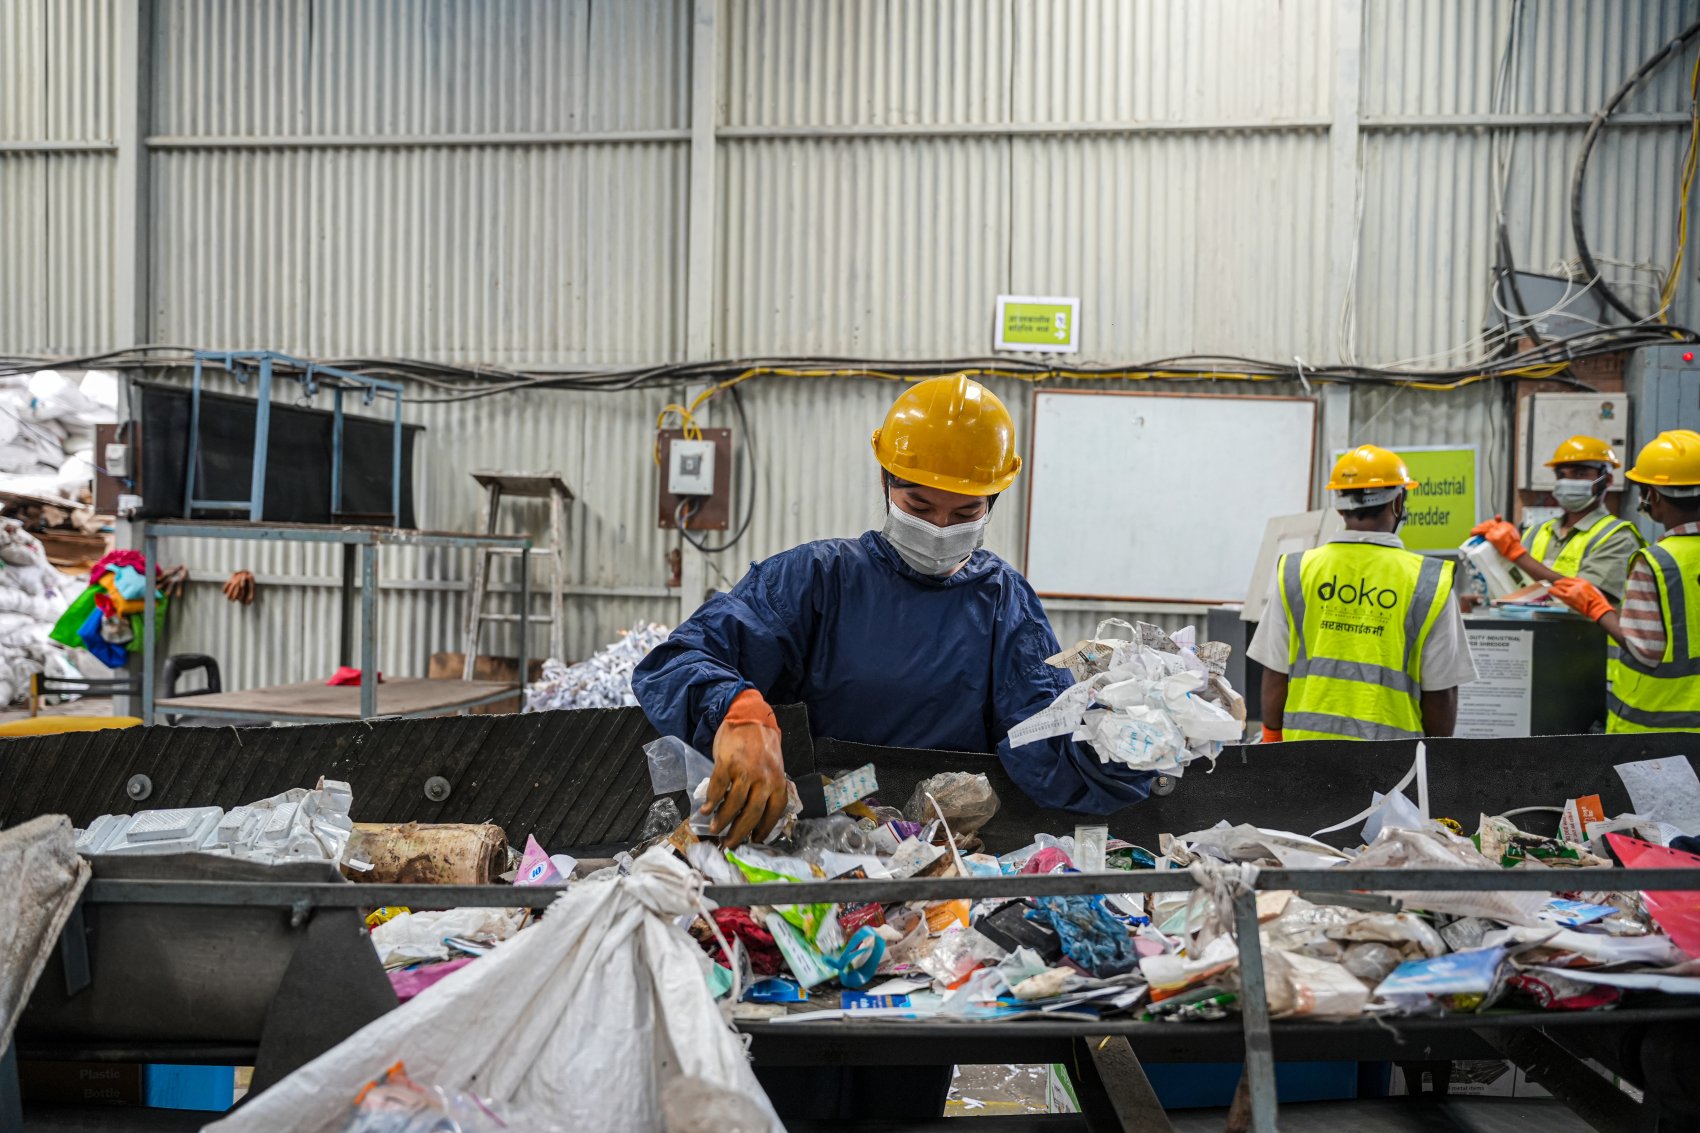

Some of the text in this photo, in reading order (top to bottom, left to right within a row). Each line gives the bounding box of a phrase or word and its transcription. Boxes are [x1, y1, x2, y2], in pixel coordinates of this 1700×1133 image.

[1404, 506, 1450, 526] hredder
[1318, 574, 1397, 609] doko
[79, 1068, 121, 1080] Plastic
[83, 1088, 121, 1099] Bottle
